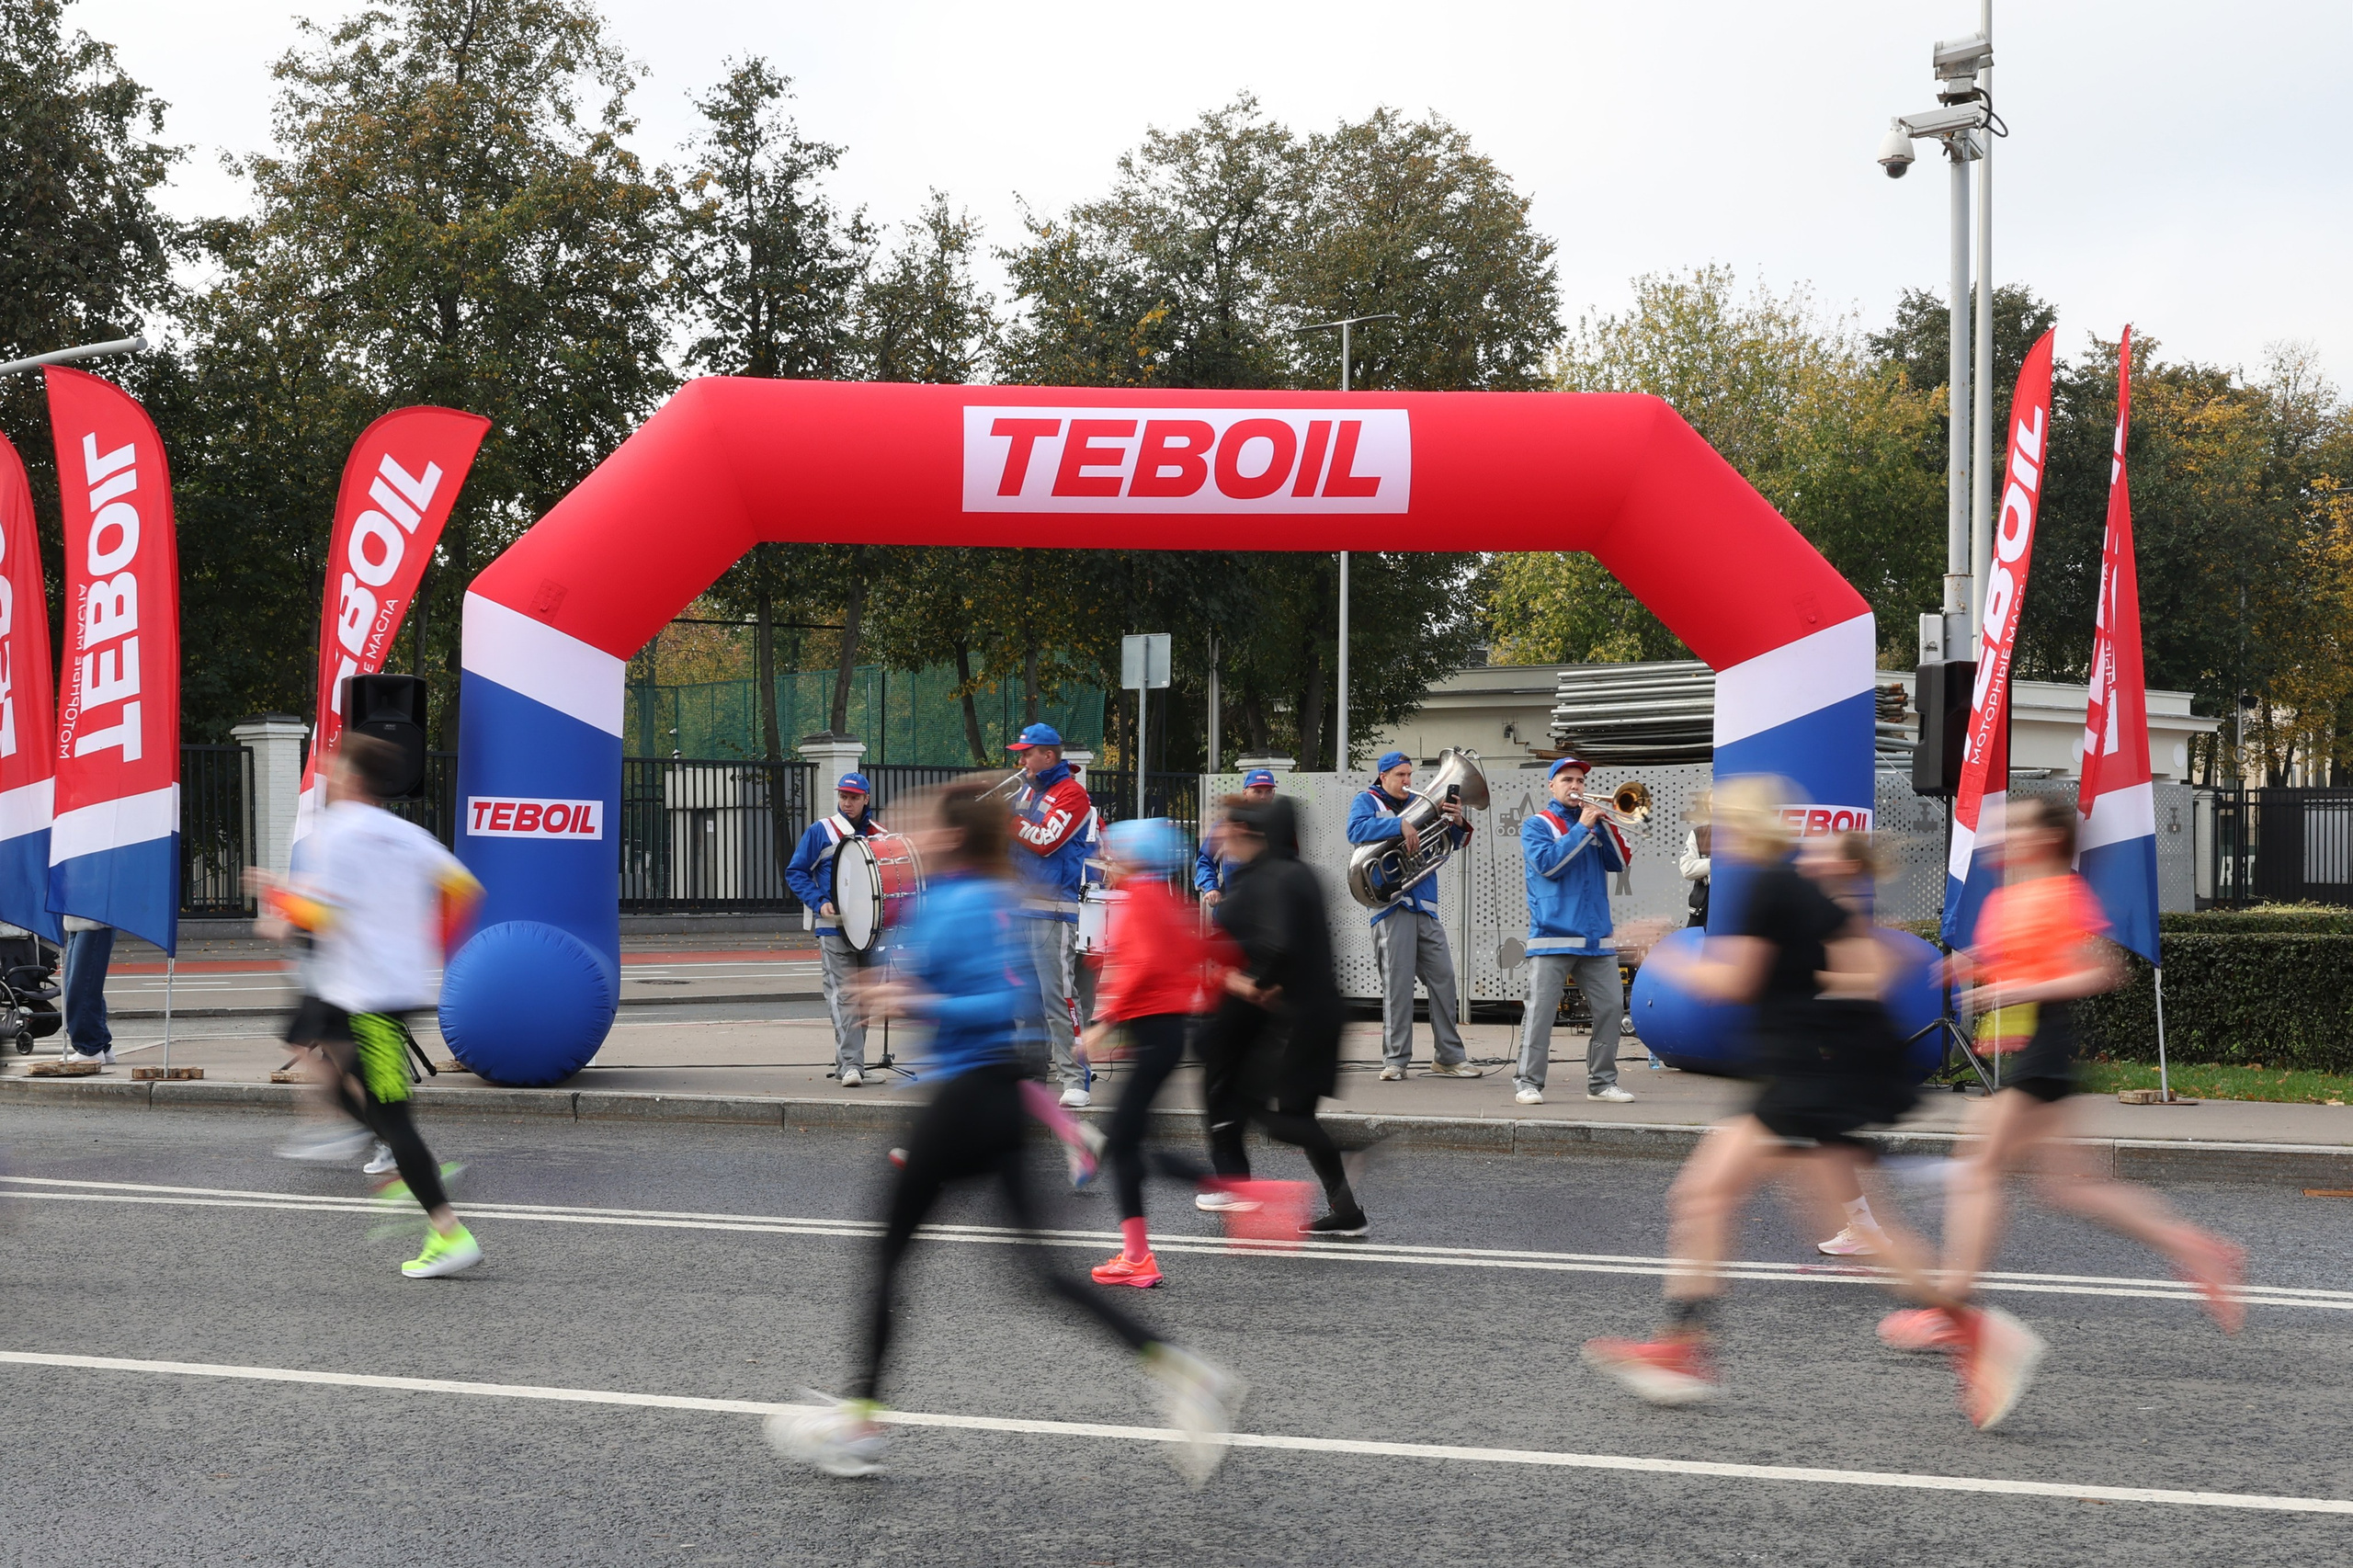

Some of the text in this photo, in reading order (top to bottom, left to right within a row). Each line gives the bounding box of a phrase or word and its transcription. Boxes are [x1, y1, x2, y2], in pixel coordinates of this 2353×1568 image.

[989, 418, 1381, 499] TEBOIL
[366, 599, 399, 659] МАСЛА
[1971, 646, 2011, 765] МОТОРНЫЕ
[473, 801, 596, 834] TEBOIL
[1017, 809, 1073, 846] TEBOIL
